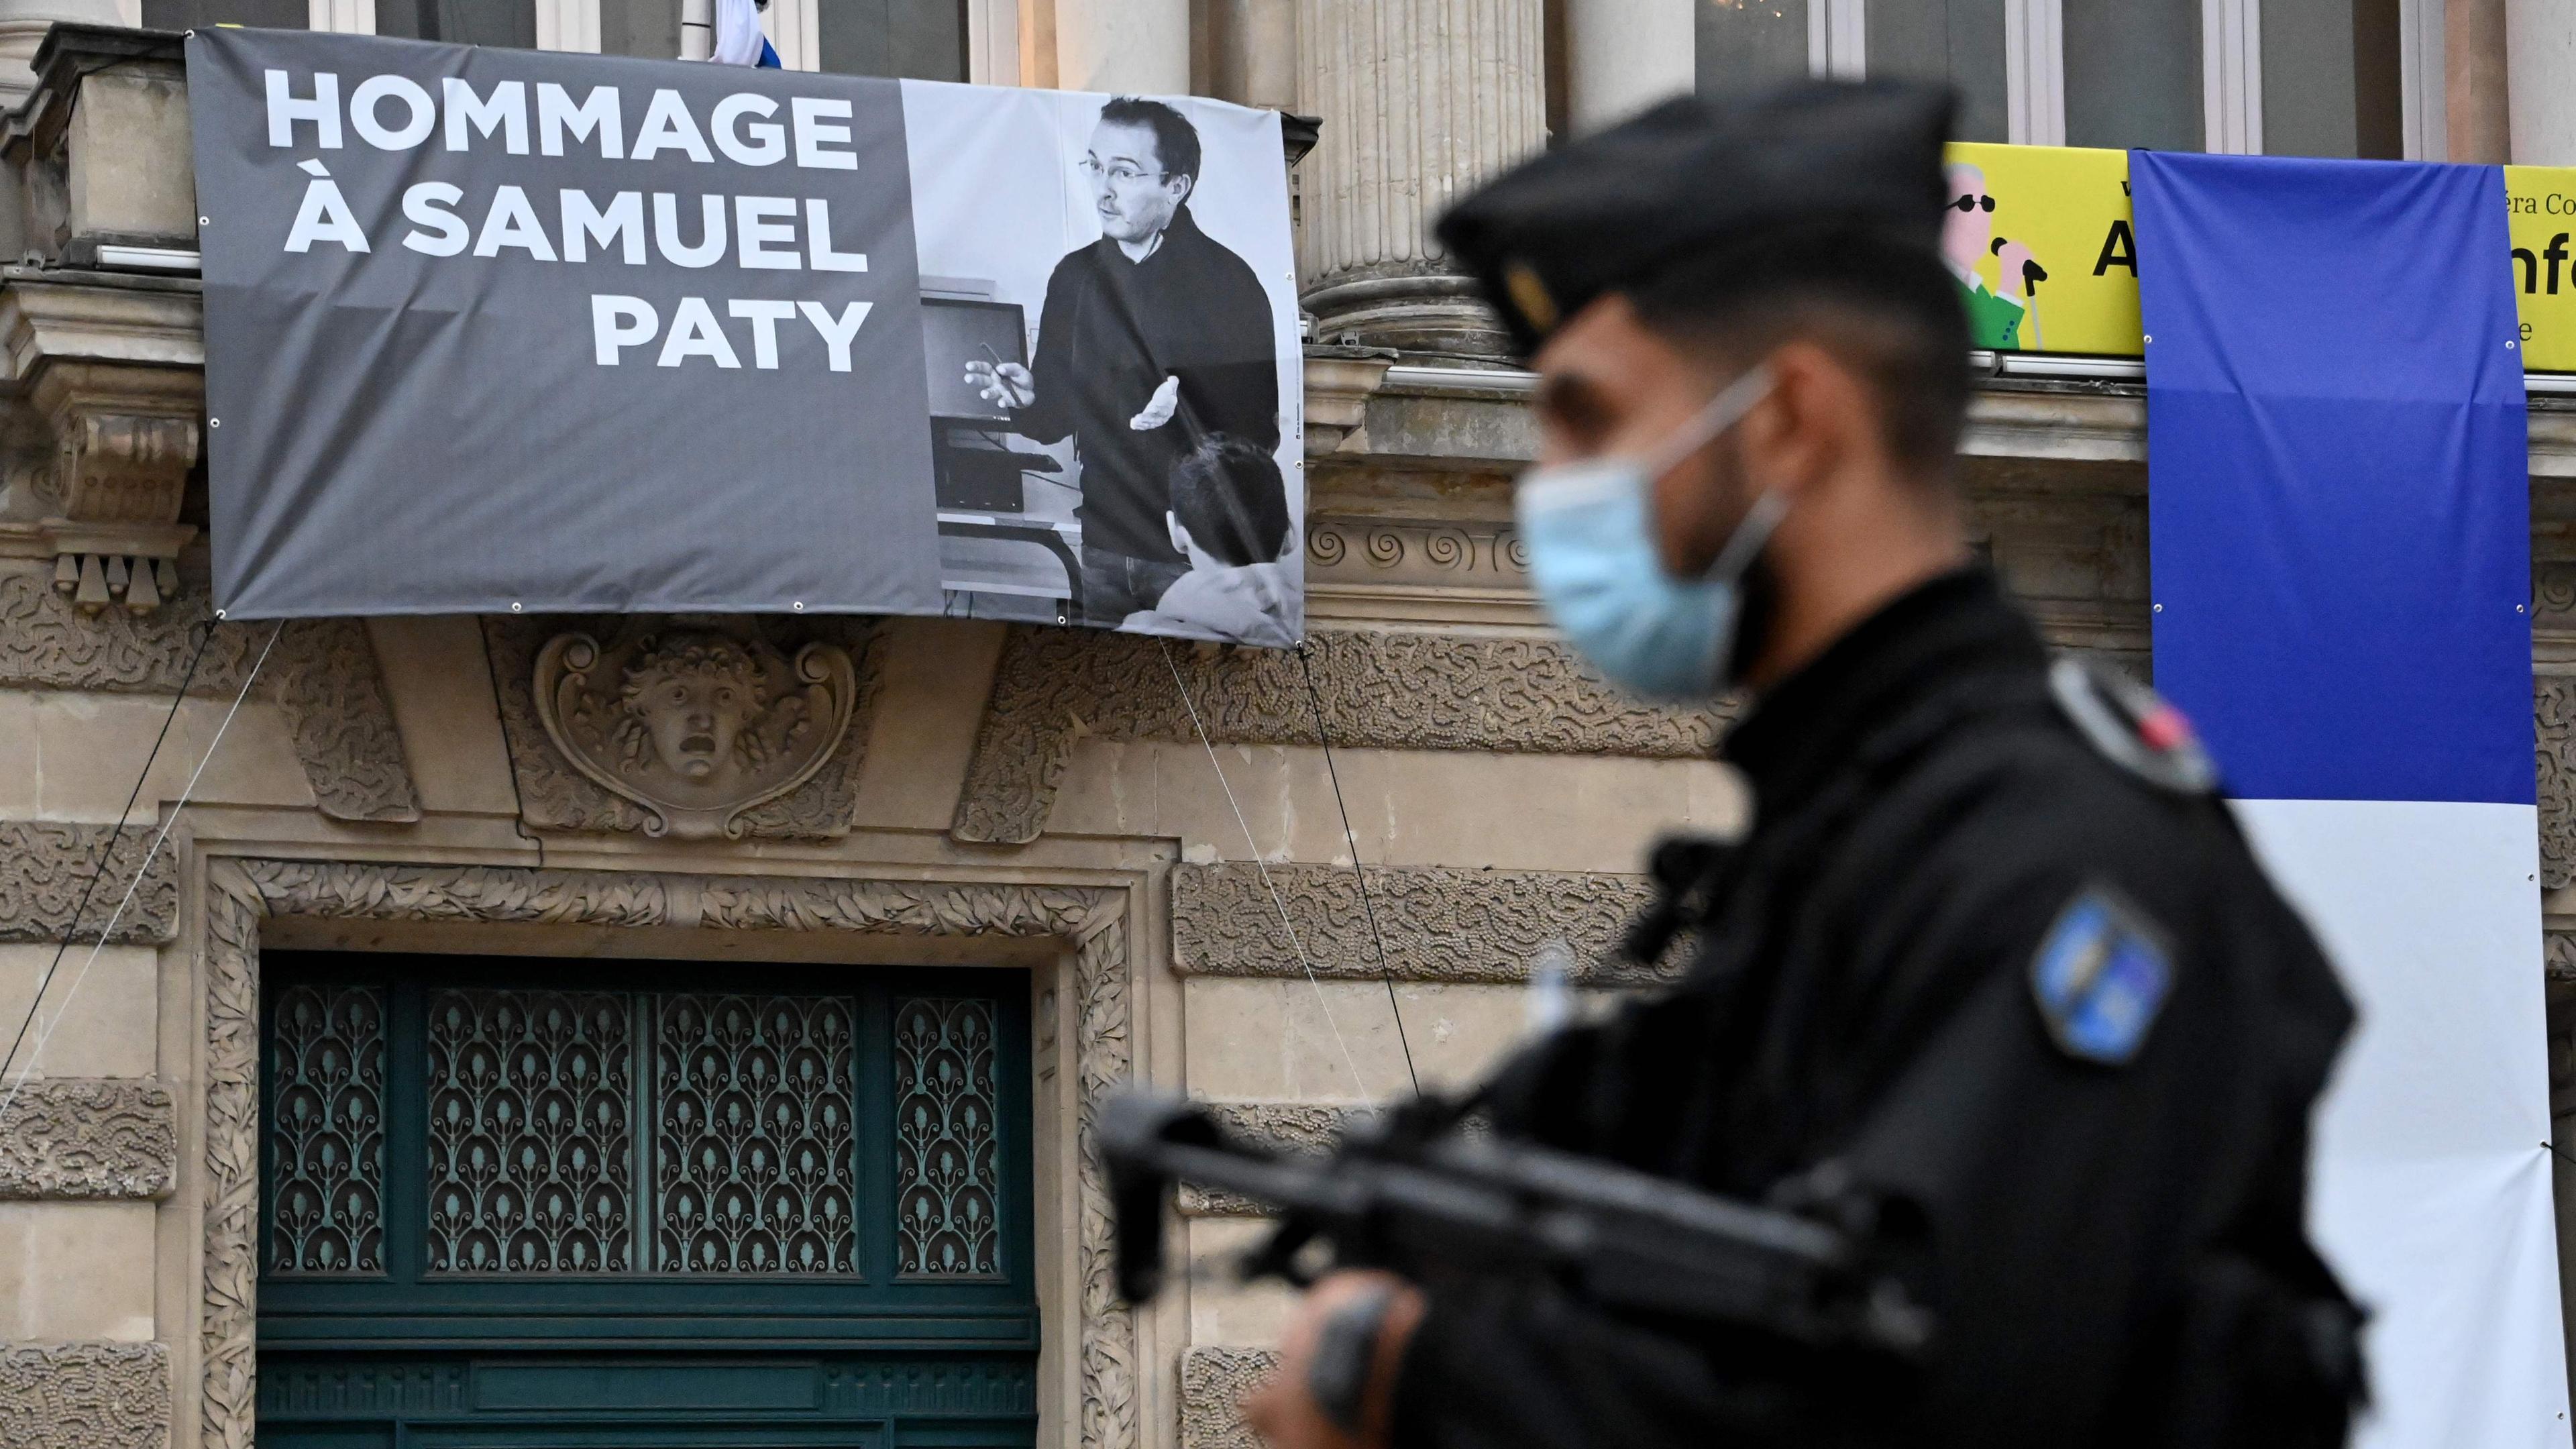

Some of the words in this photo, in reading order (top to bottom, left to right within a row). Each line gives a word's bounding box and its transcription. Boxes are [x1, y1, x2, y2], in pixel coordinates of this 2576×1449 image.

[264, 69, 858, 170] HOMMAGE
[283, 158, 371, 254] À
[402, 181, 869, 272] SAMUEL
[2092, 220, 2139, 278] A
[2511, 232, 2576, 295] nf
[591, 294, 873, 372] PATY
